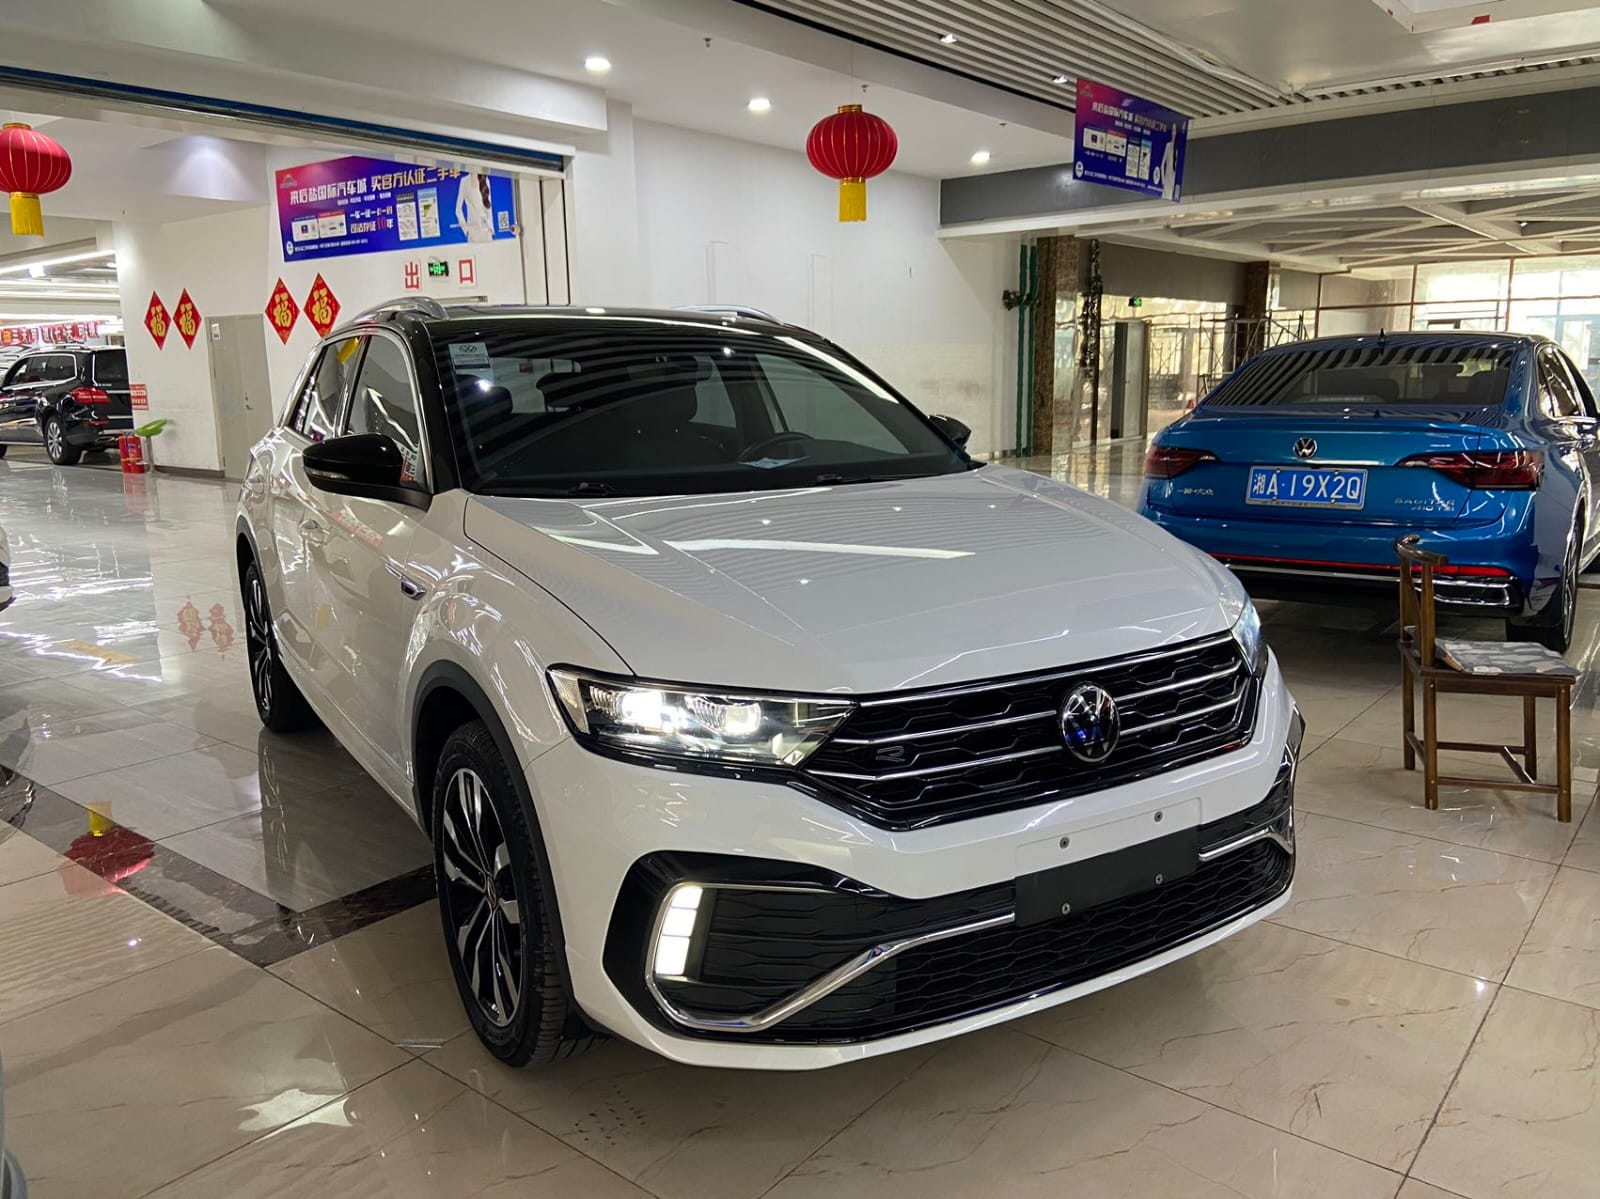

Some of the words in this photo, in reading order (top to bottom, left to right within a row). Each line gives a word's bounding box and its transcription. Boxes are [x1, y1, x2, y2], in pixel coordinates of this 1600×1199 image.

[405, 261, 419, 288] 出
[459, 259, 473, 283] 口
[152, 304, 167, 337] 福
[180, 303, 194, 336] 福
[274, 292, 291, 328] 福
[313, 288, 331, 322] 福
